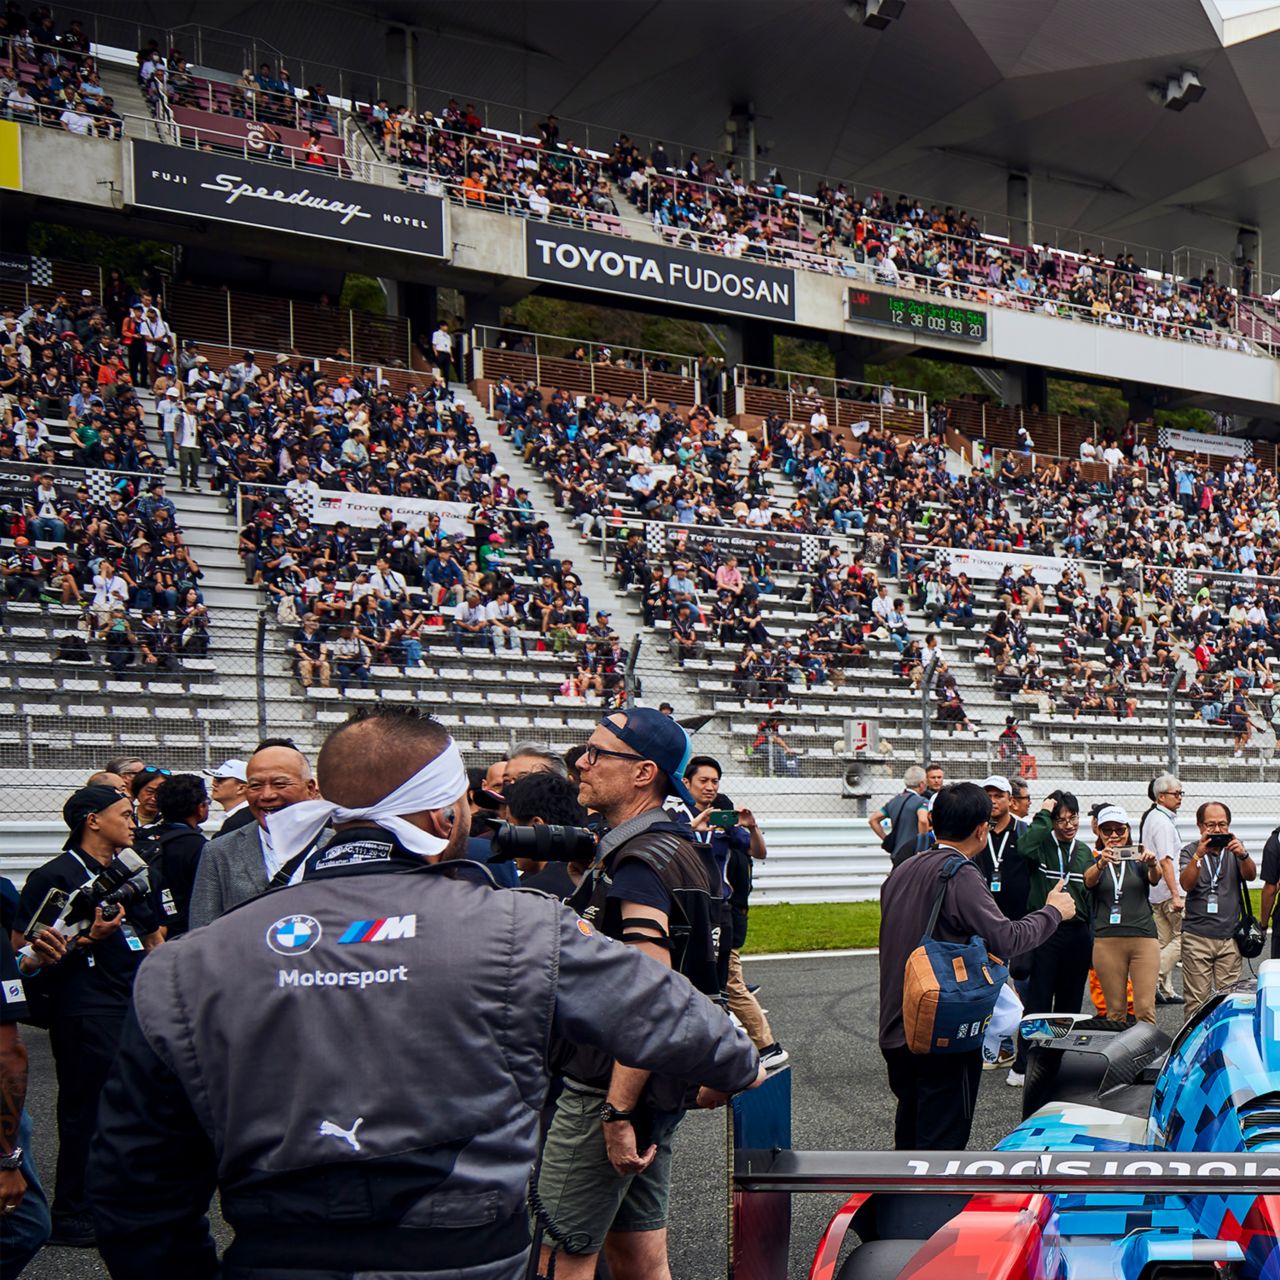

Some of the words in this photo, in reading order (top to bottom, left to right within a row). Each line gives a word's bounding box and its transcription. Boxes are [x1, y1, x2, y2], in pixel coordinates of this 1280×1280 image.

[151, 169, 188, 185] FUJI
[201, 173, 372, 226] Speedway
[383, 212, 429, 230] HOTEL
[535, 238, 664, 284] TOYOTA
[668, 263, 789, 307] FUDOSAN
[892, 310, 903, 324] 12
[970, 324, 981, 337] 20
[278, 965, 409, 989] Motorsport
